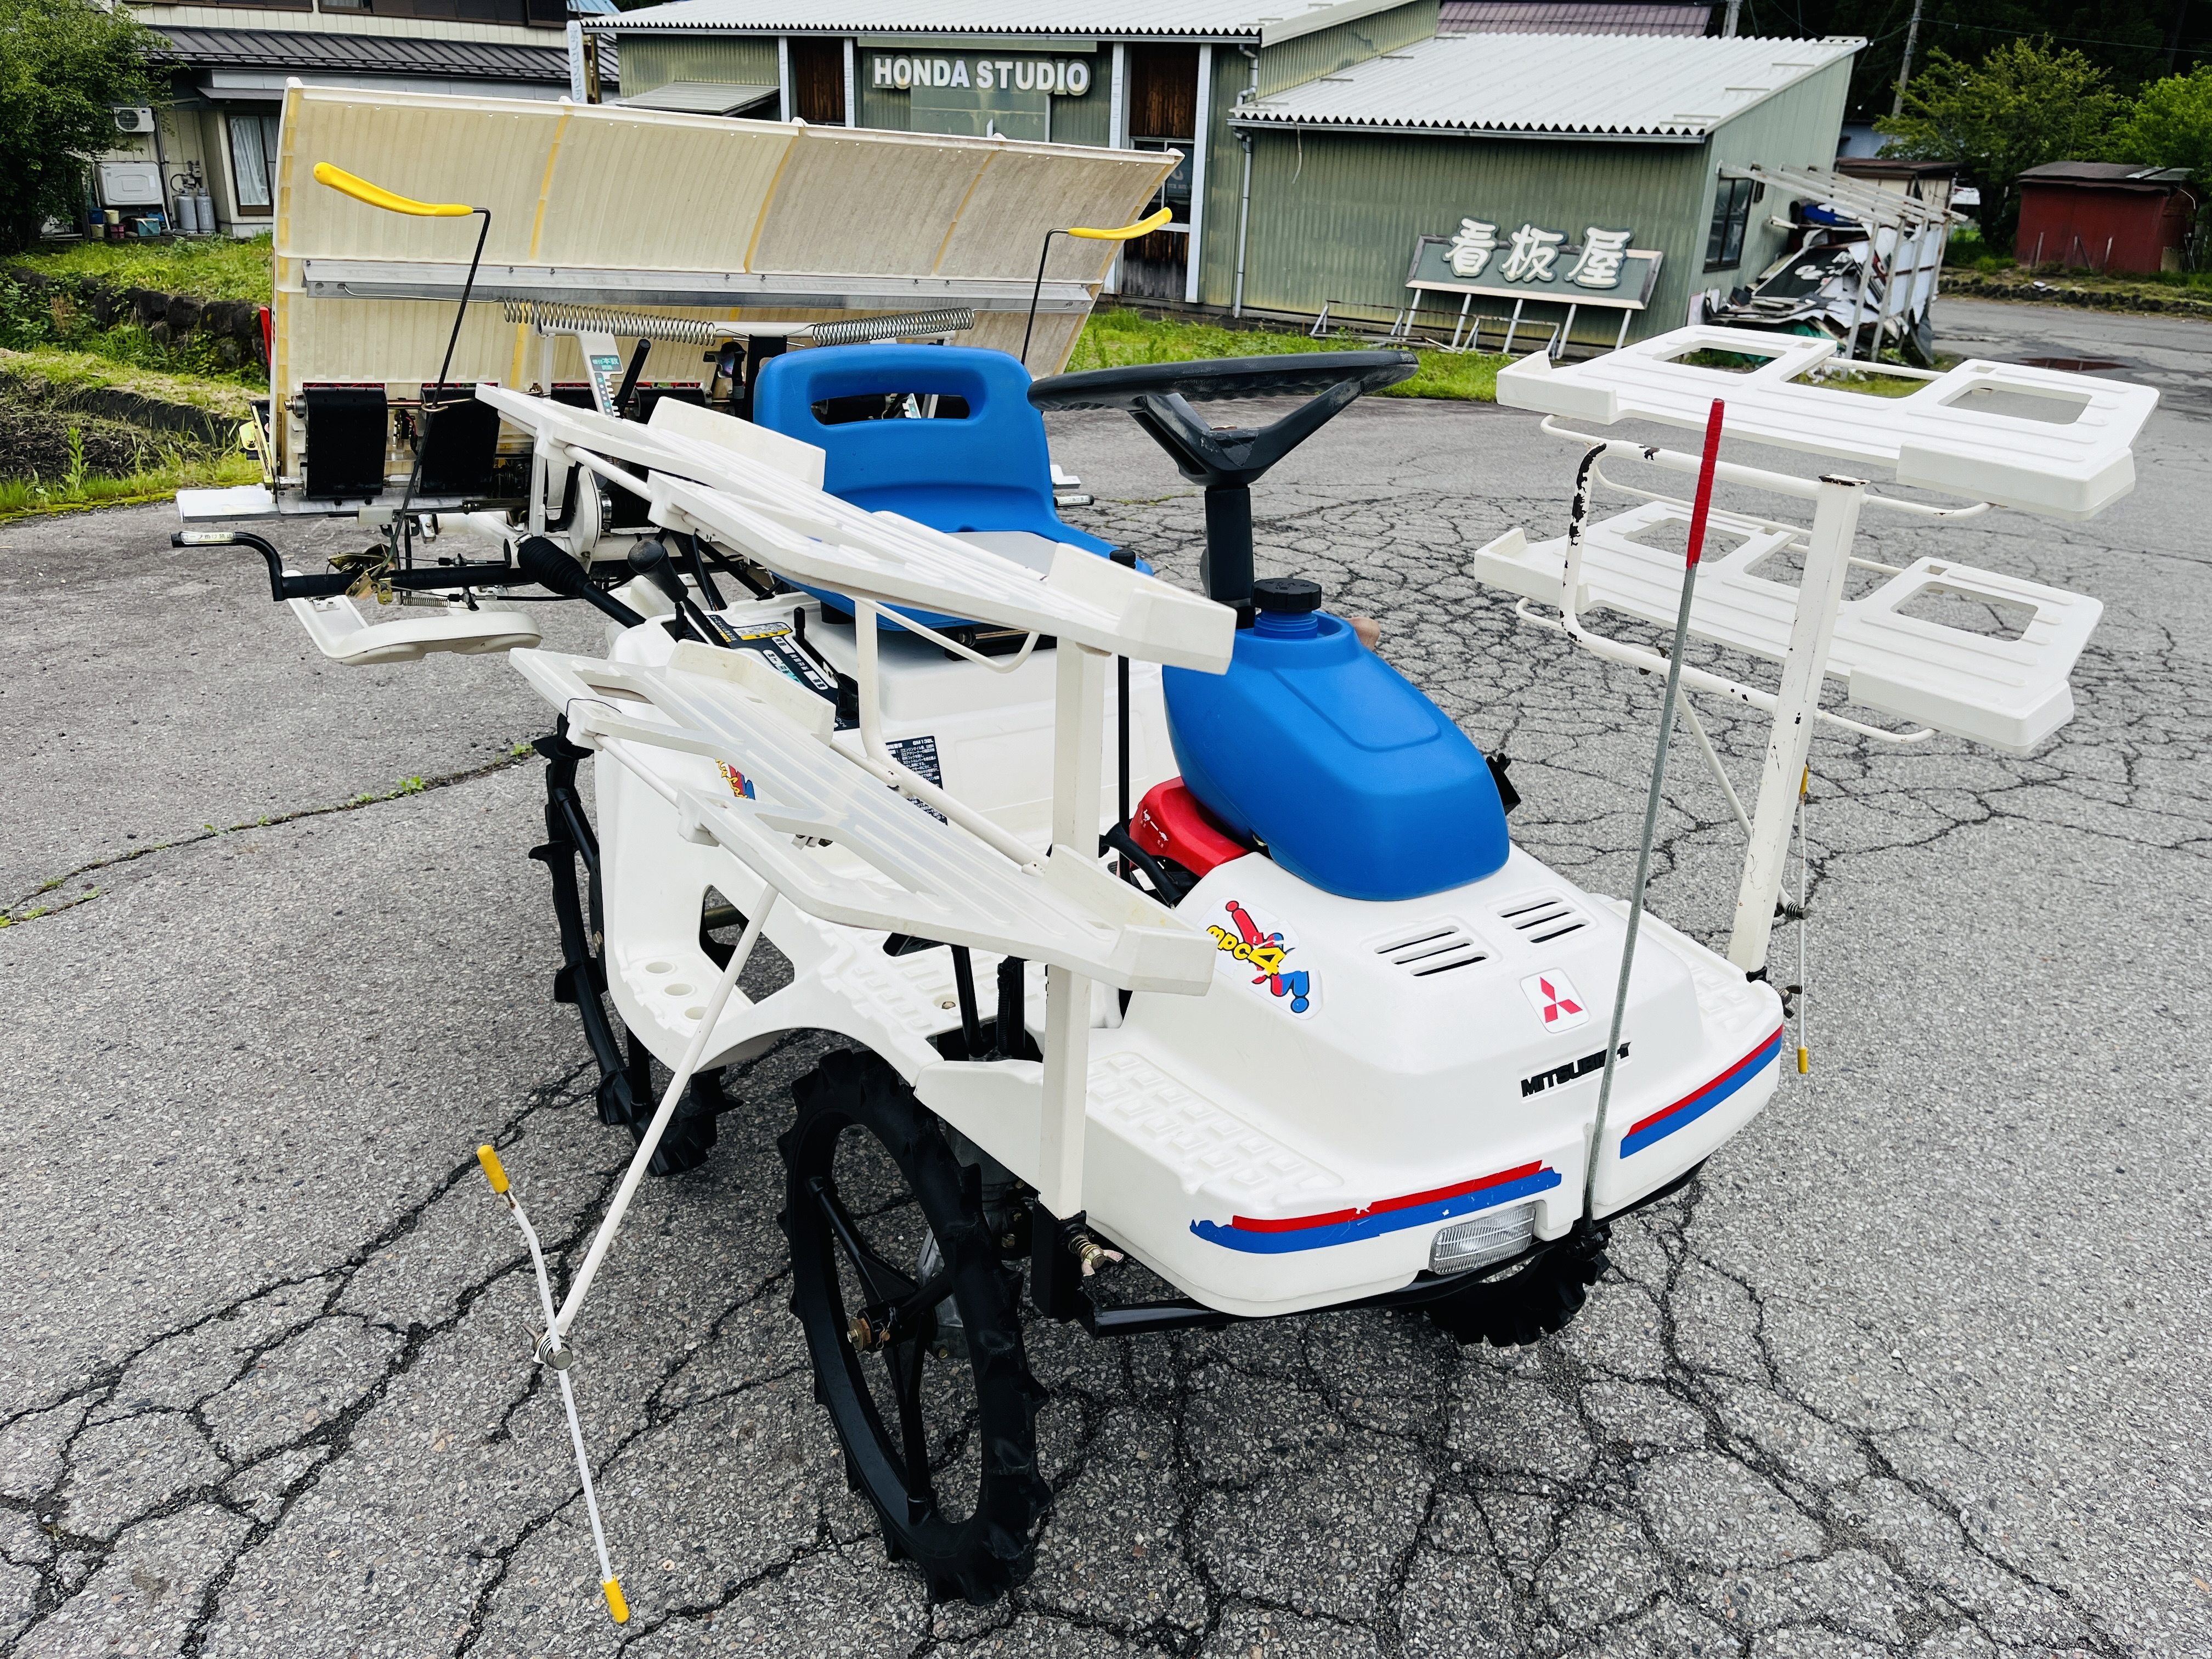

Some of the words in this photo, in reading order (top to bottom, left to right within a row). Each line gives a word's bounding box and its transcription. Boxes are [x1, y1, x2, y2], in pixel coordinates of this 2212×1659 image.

[874, 57, 970, 88] HONDA
[976, 59, 1089, 92] STUDIO
[1443, 217, 1632, 286] 看板屋
